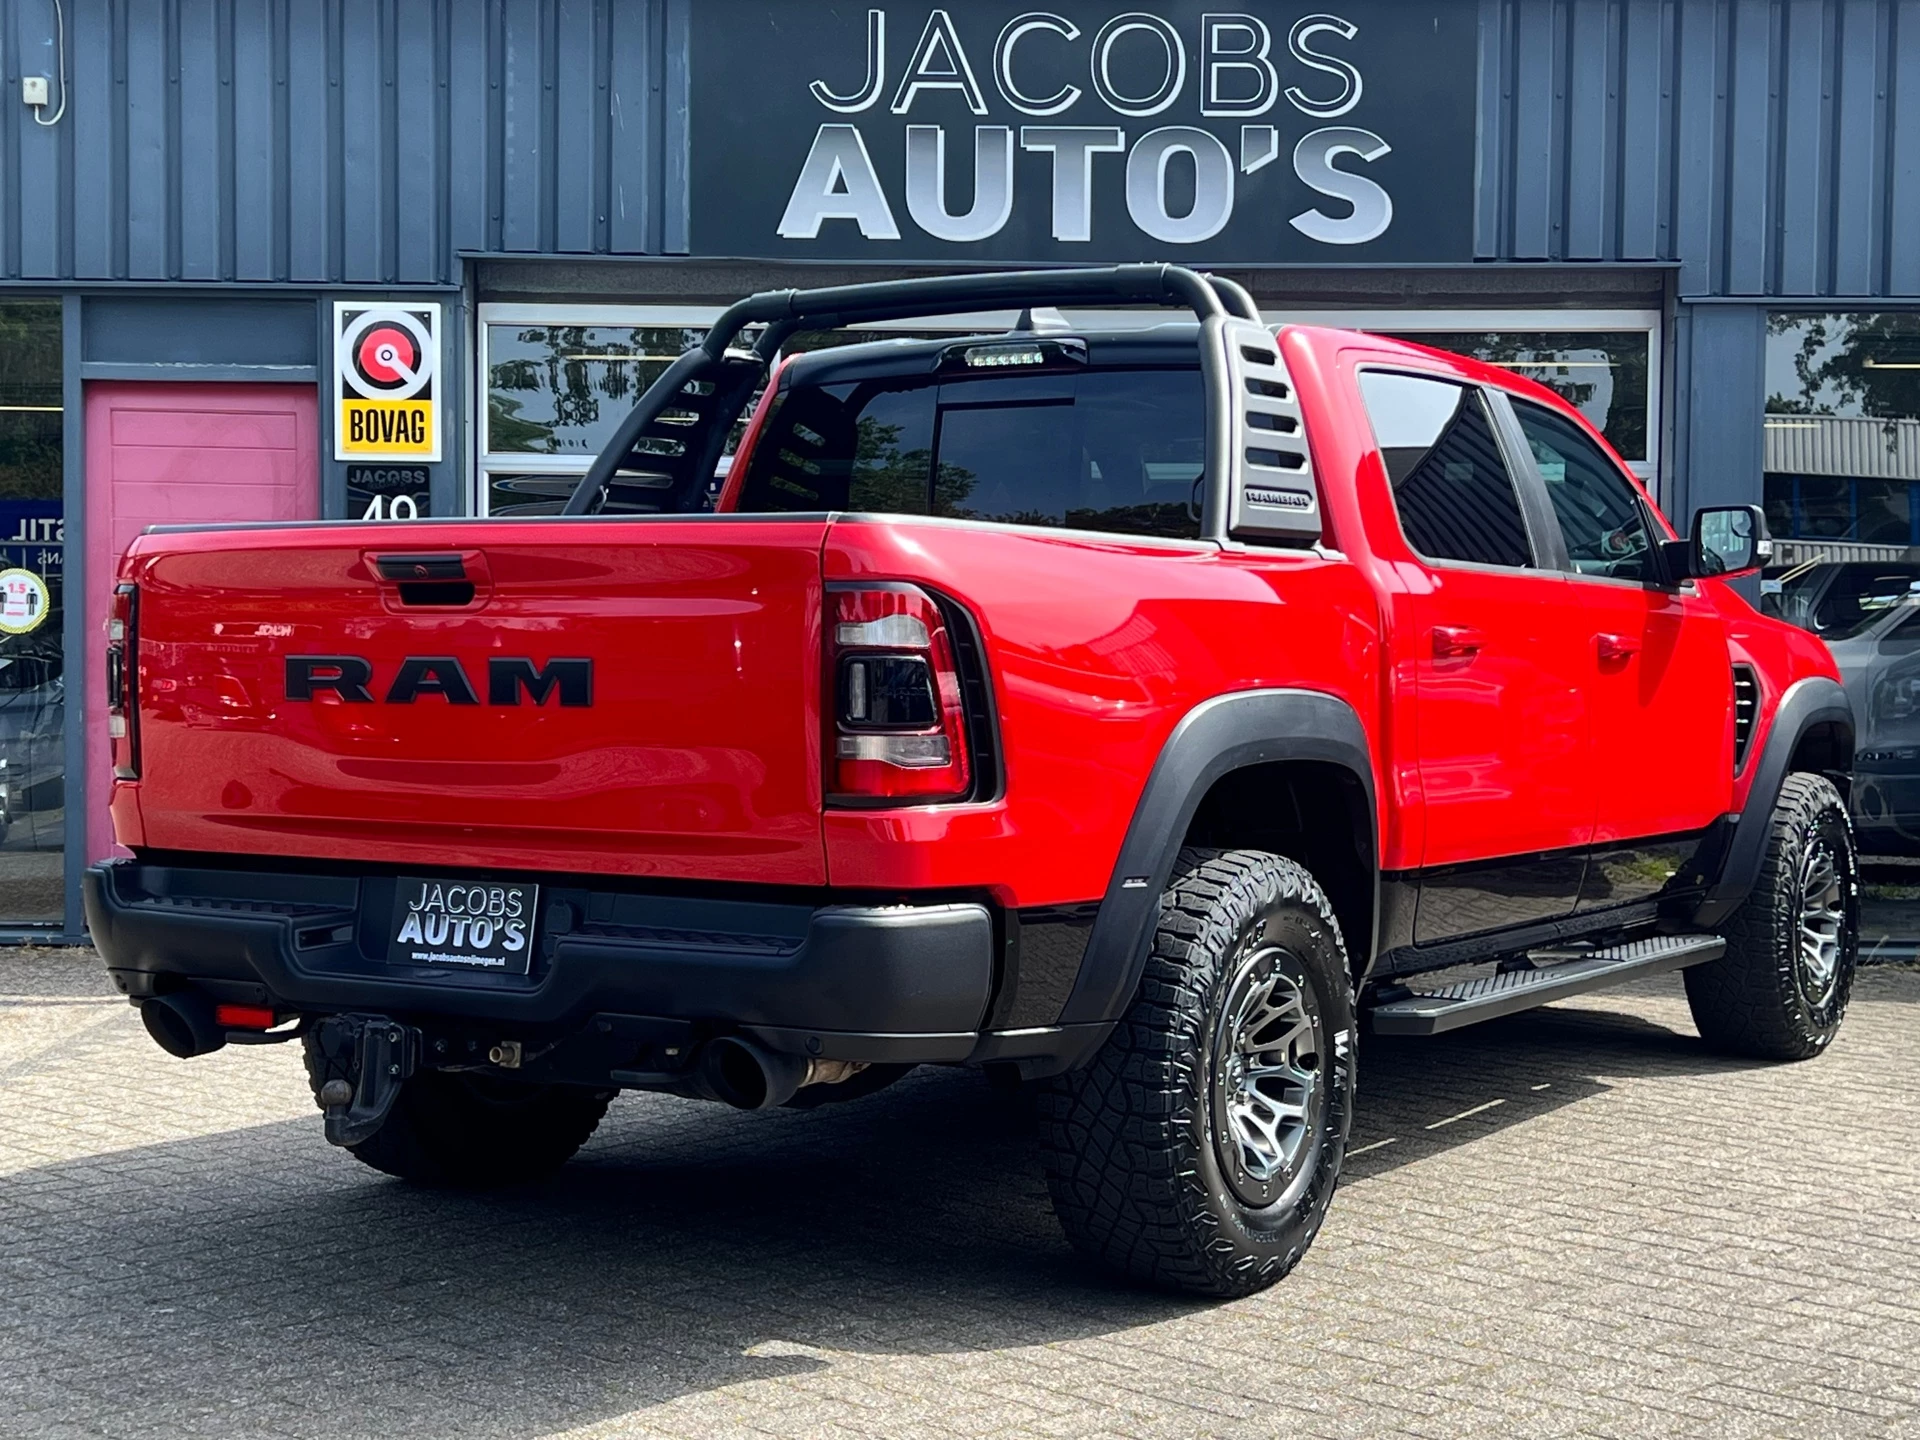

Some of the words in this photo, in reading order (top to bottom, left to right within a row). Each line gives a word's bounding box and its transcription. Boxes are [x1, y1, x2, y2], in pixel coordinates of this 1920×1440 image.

[809, 8, 1363, 118] JACOBS
[777, 124, 1393, 244] AUTO'S
[350, 408, 425, 443] BOVAG
[350, 469, 426, 484] JACOBS
[8, 582, 27, 594] 1.5
[285, 654, 593, 706] RAM
[408, 883, 523, 917] JACOBS
[397, 912, 526, 951] AUTO'S
